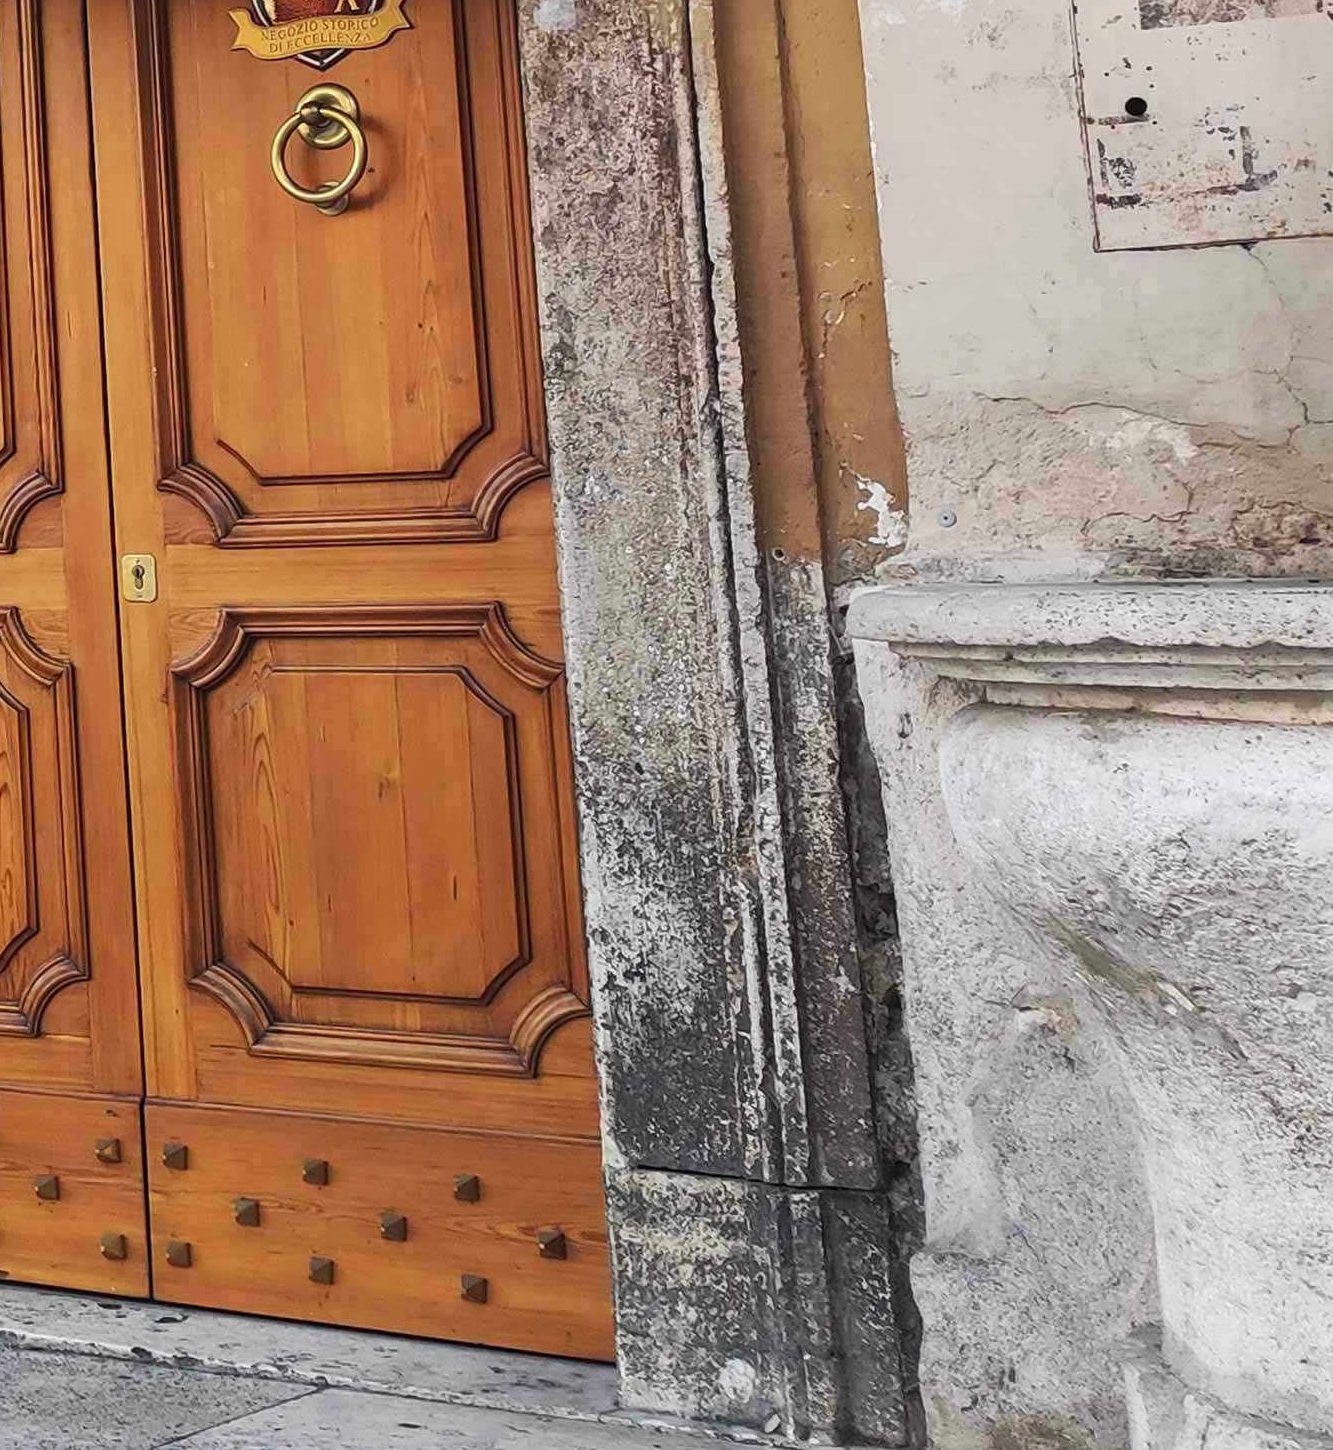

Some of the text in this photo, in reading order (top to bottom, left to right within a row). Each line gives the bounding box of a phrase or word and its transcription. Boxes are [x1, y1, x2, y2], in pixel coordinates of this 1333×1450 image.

[261, 17, 379, 41] NEGOZIO STORICO
[269, 32, 372, 53] DI ECCELLENZA
